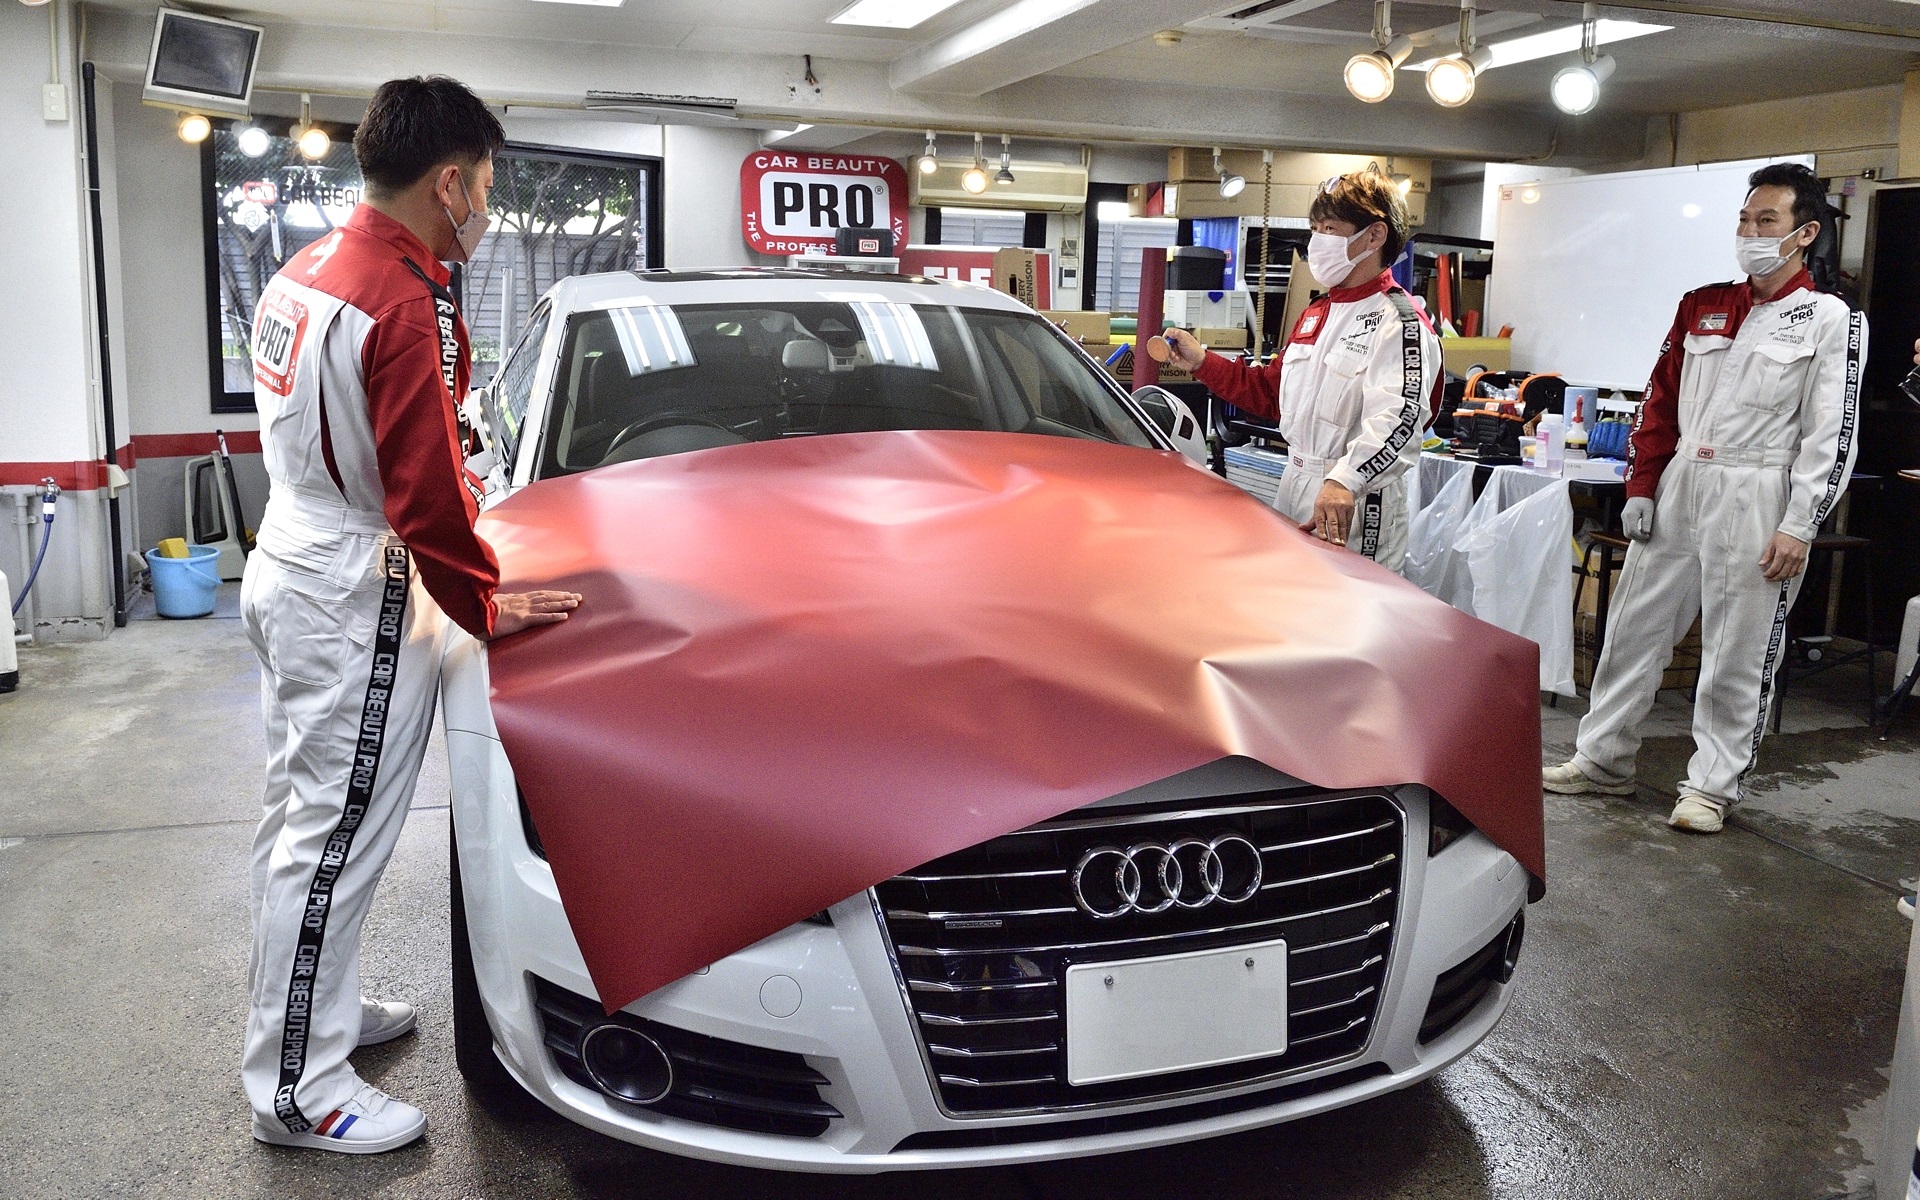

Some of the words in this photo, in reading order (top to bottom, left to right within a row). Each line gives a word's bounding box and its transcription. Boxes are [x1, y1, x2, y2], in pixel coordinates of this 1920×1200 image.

[755, 156, 798, 169] CAR
[808, 157, 890, 175] BEAUTY
[279, 183, 317, 205] CAR
[746, 211, 762, 242] THE
[766, 241, 837, 253] PROFESS
[892, 217, 903, 246] WAY
[1018, 278, 1026, 304] VERY
[1025, 260, 1034, 309] DENNISON
[1404, 321, 1419, 341] RO
[1791, 308, 1814, 324] PRO
[438, 316, 460, 386] BEAUTY
[1849, 327, 1860, 351] PRO
[1405, 347, 1421, 369] CAR
[1846, 359, 1858, 382] CAR
[1404, 370, 1421, 403] BEAUT
[1842, 383, 1857, 427] BEAUTY
[1389, 425, 1412, 449] CAR
[1838, 427, 1851, 452] PRO
[1829, 461, 1845, 485] CAR
[1365, 503, 1380, 528] CAR
[1814, 482, 1838, 526] BEAUTY
[386, 546, 407, 601] EAUTY
[1775, 600, 1787, 622] CAR
[1765, 622, 1783, 662] BEAUTY
[371, 652, 395, 686] CAR
[360, 687, 389, 754] BEAUTY
[338, 804, 365, 831] CAR
[313, 829, 352, 892] BEAUTY
[294, 944, 318, 978] CAR
[286, 979, 312, 1043] BEAUTY
[275, 1084, 294, 1118] CAR
